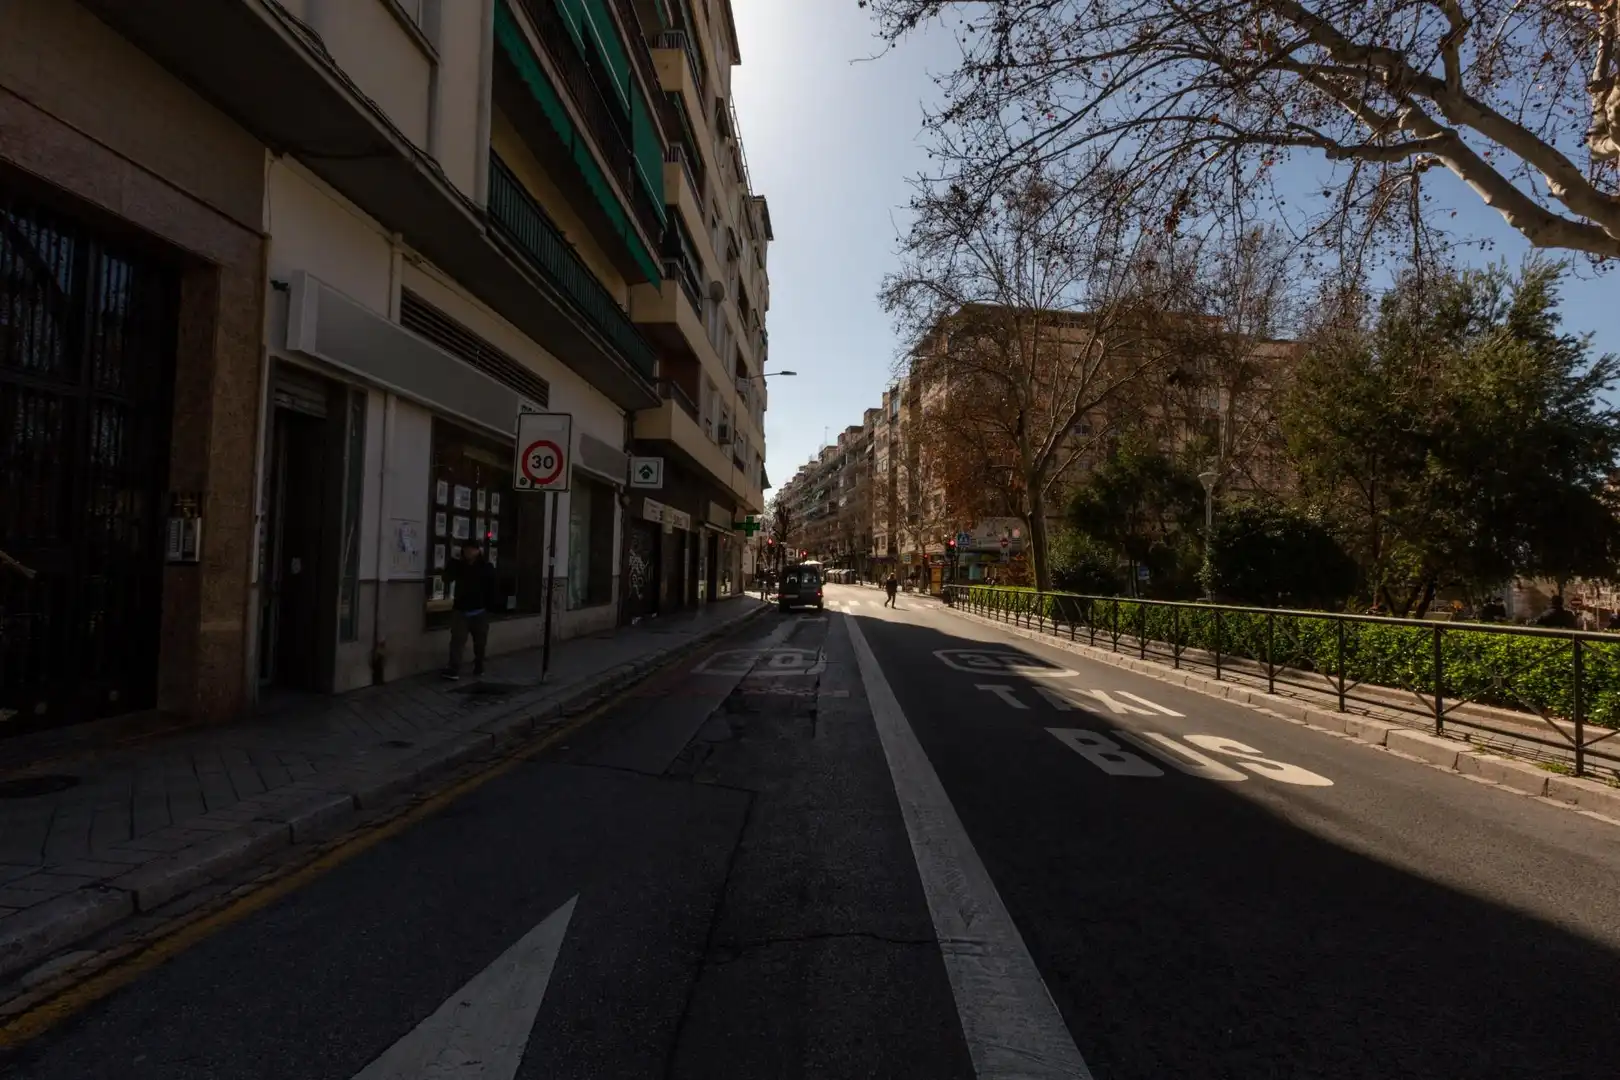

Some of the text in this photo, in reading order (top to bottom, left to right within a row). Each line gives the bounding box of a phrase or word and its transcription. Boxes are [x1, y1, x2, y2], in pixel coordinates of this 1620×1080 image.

[531, 455, 554, 470] 30
[956, 653, 1048, 669] 30
[974, 683, 1186, 717] TAXI
[1044, 727, 1334, 786] BUS
